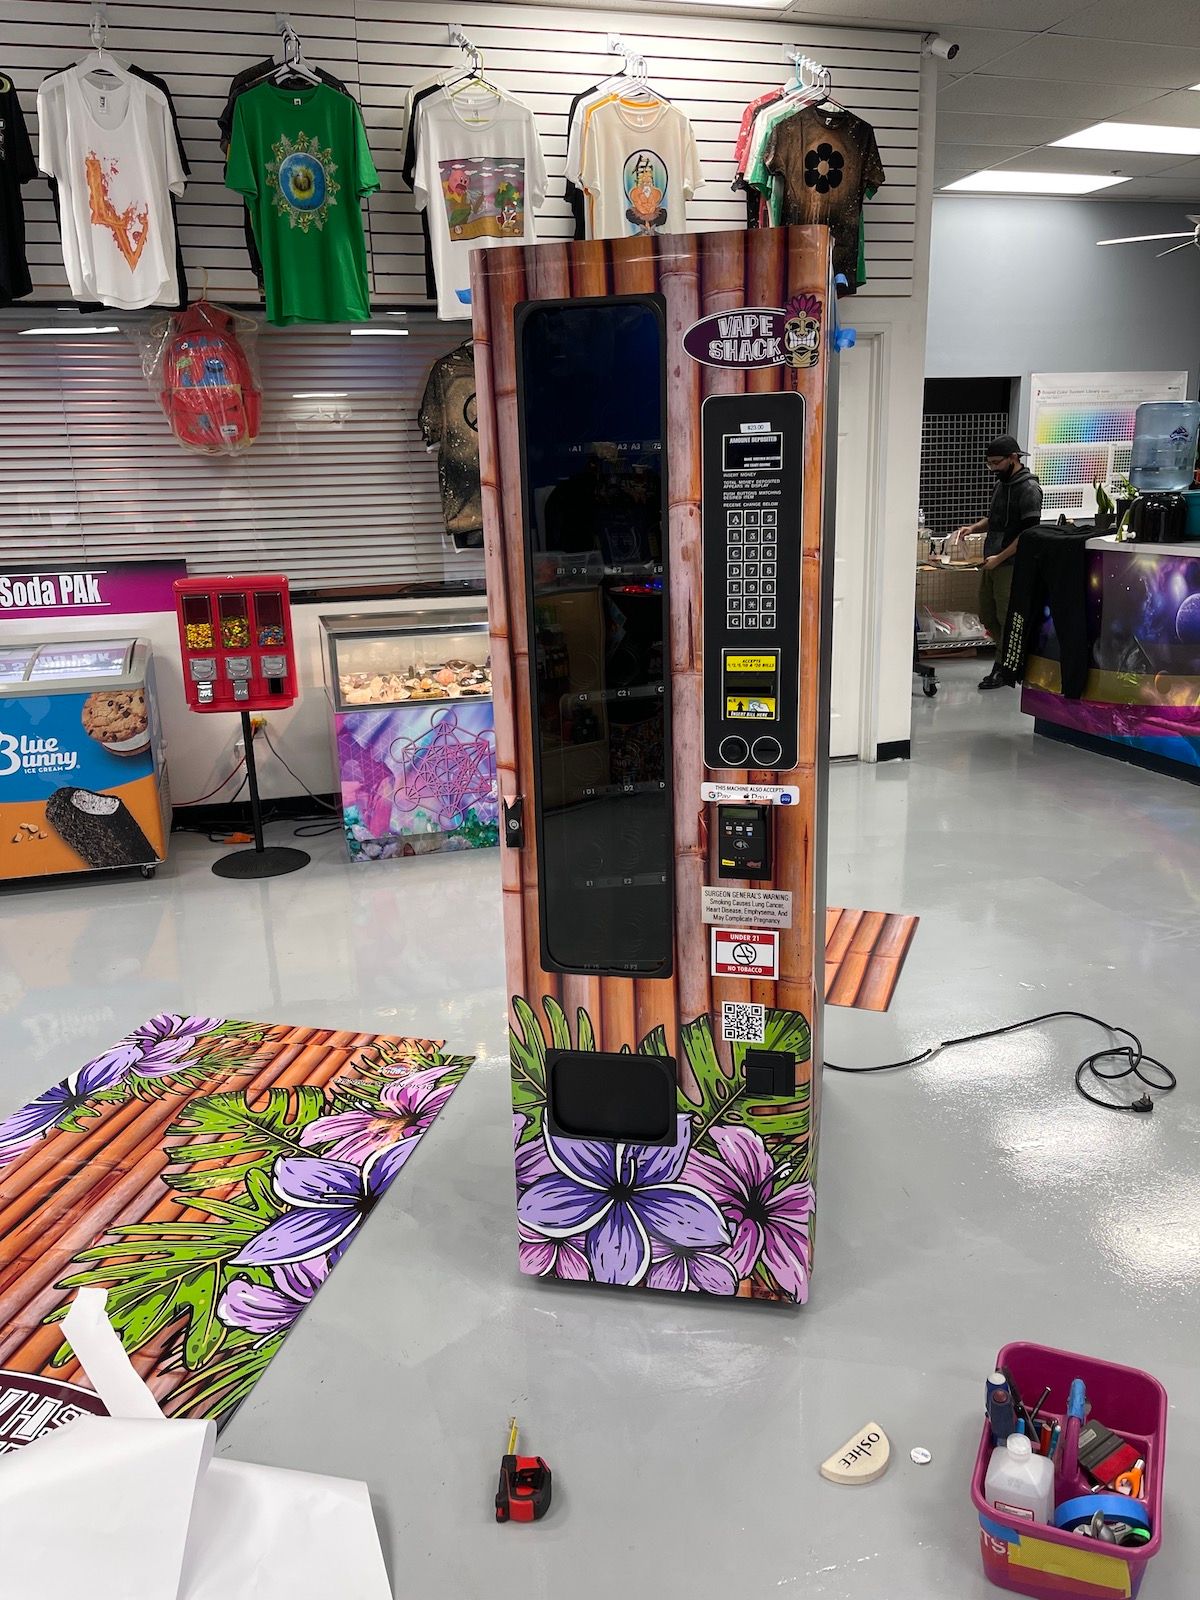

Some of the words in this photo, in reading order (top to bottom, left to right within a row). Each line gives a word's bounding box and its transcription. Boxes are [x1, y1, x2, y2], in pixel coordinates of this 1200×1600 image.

[718, 315, 774, 338] VAPE
[708, 337, 781, 362] SHACK
[772, 355, 785, 363] LLC
[0, 576, 55, 608] Soda
[59, 574, 102, 604] PAk
[763, 893, 788, 901] WARNING
[838, 1432, 880, 1469] OSHEE
